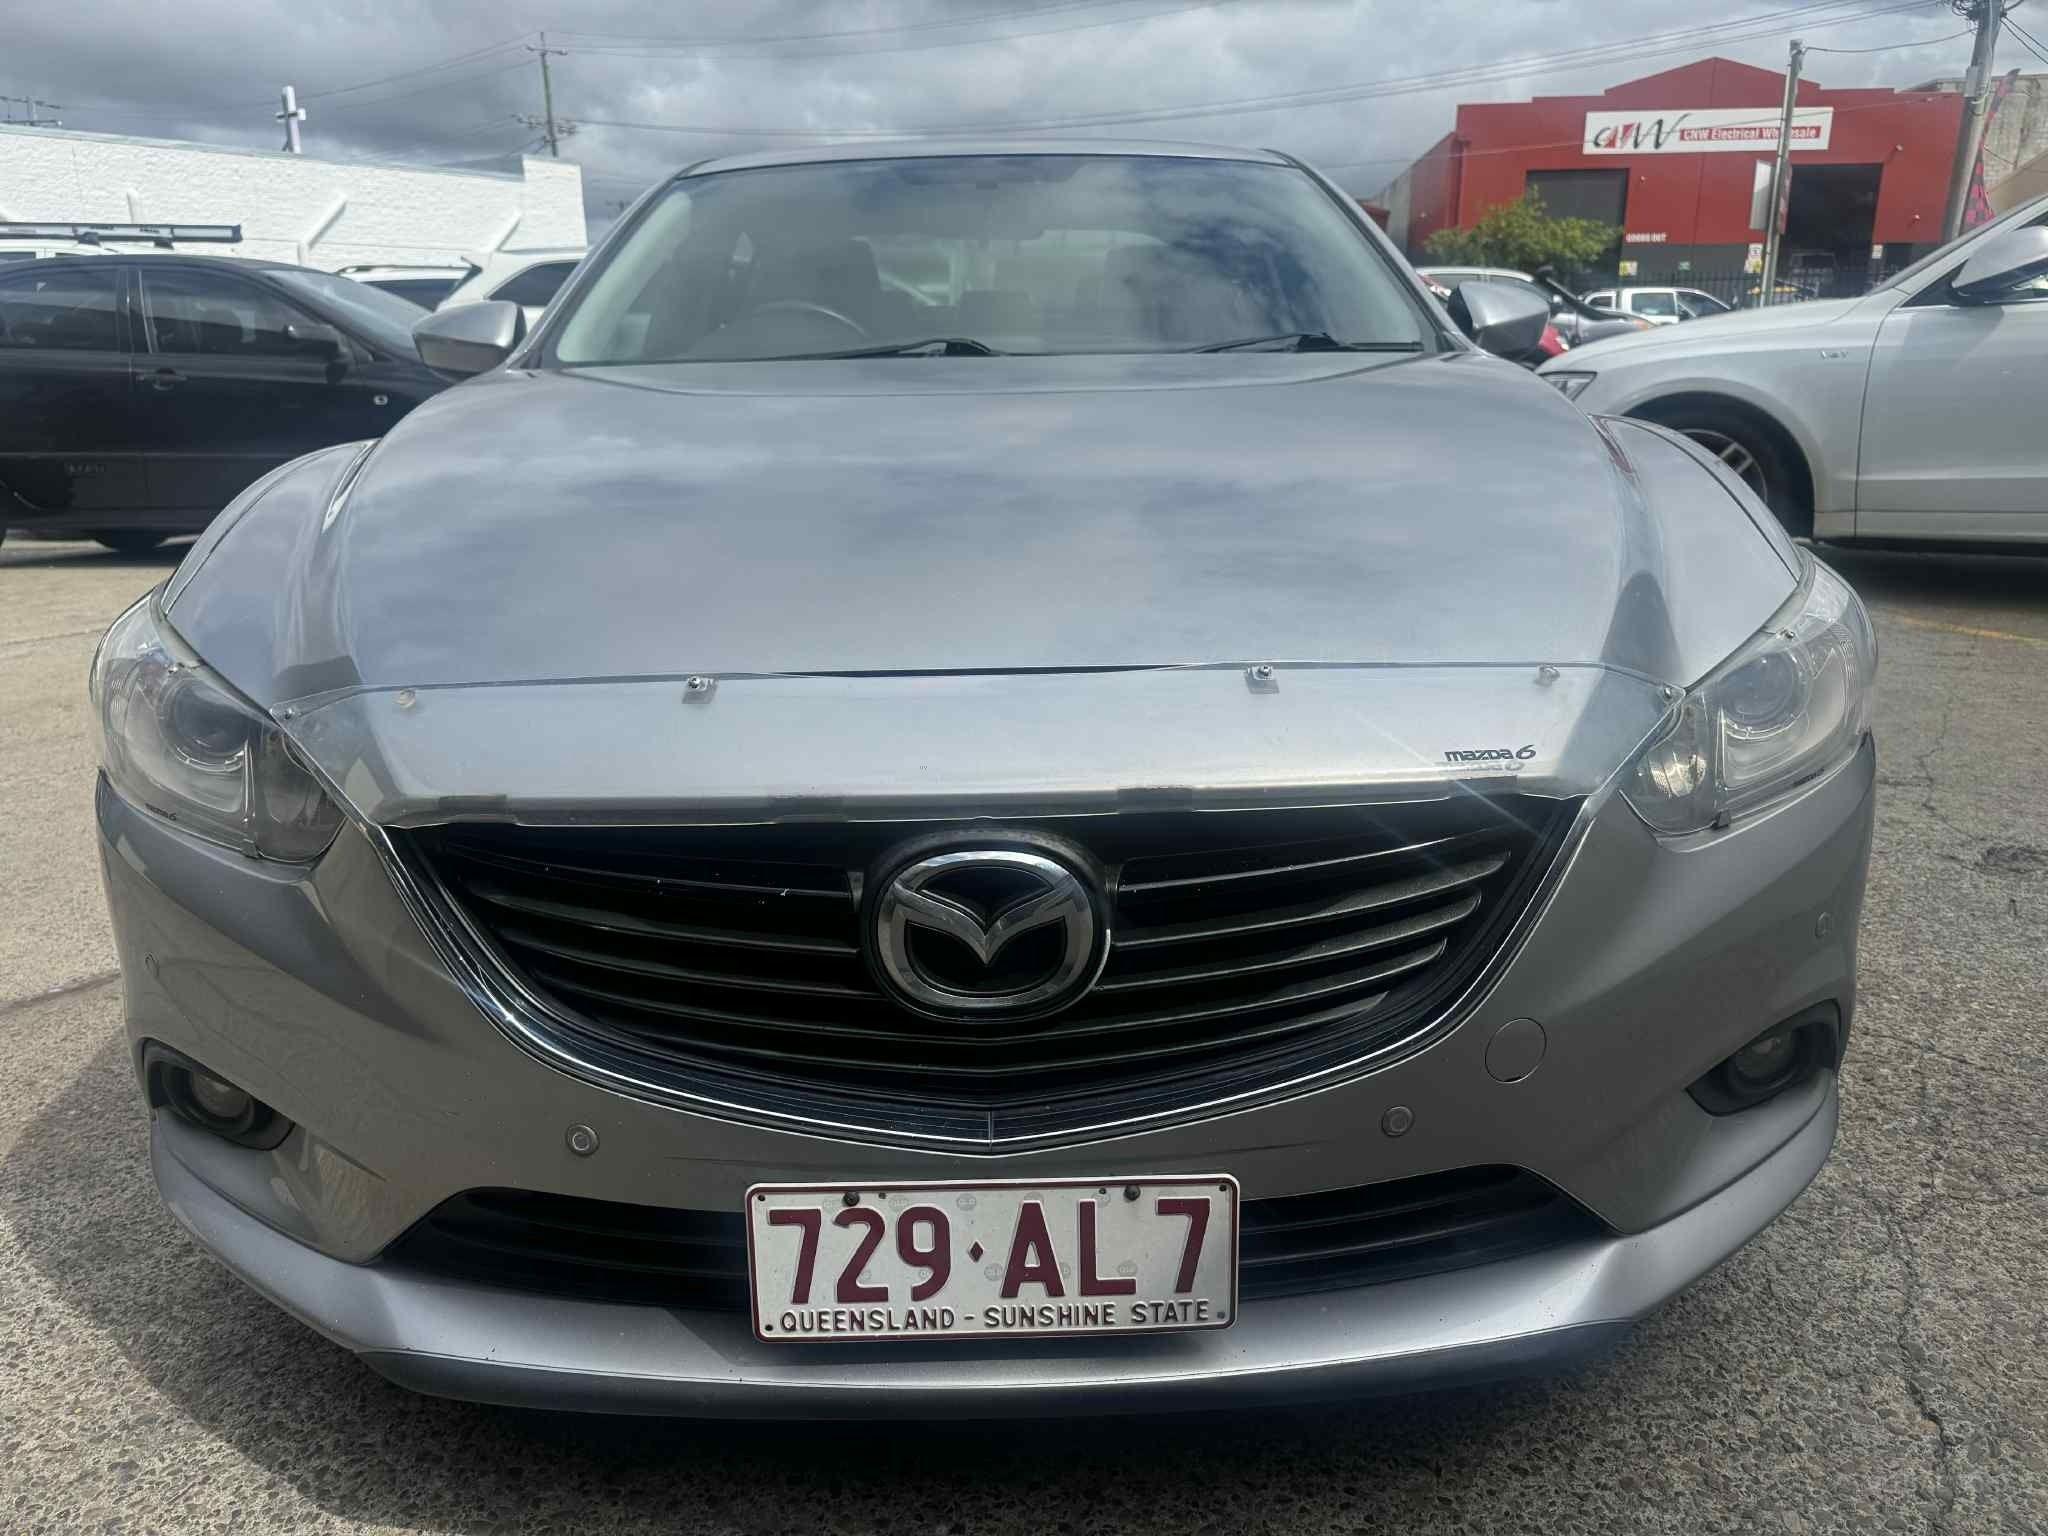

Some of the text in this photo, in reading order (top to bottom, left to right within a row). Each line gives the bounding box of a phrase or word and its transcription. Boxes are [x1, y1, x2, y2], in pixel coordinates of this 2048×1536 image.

[1684, 129, 1709, 141] CNW
[1711, 128, 1760, 141] Electrical
[780, 1308, 955, 1333] QUEENSLAND
[983, 1301, 1117, 1329] SUNSHINE
[1130, 1298, 1211, 1325] STATE
